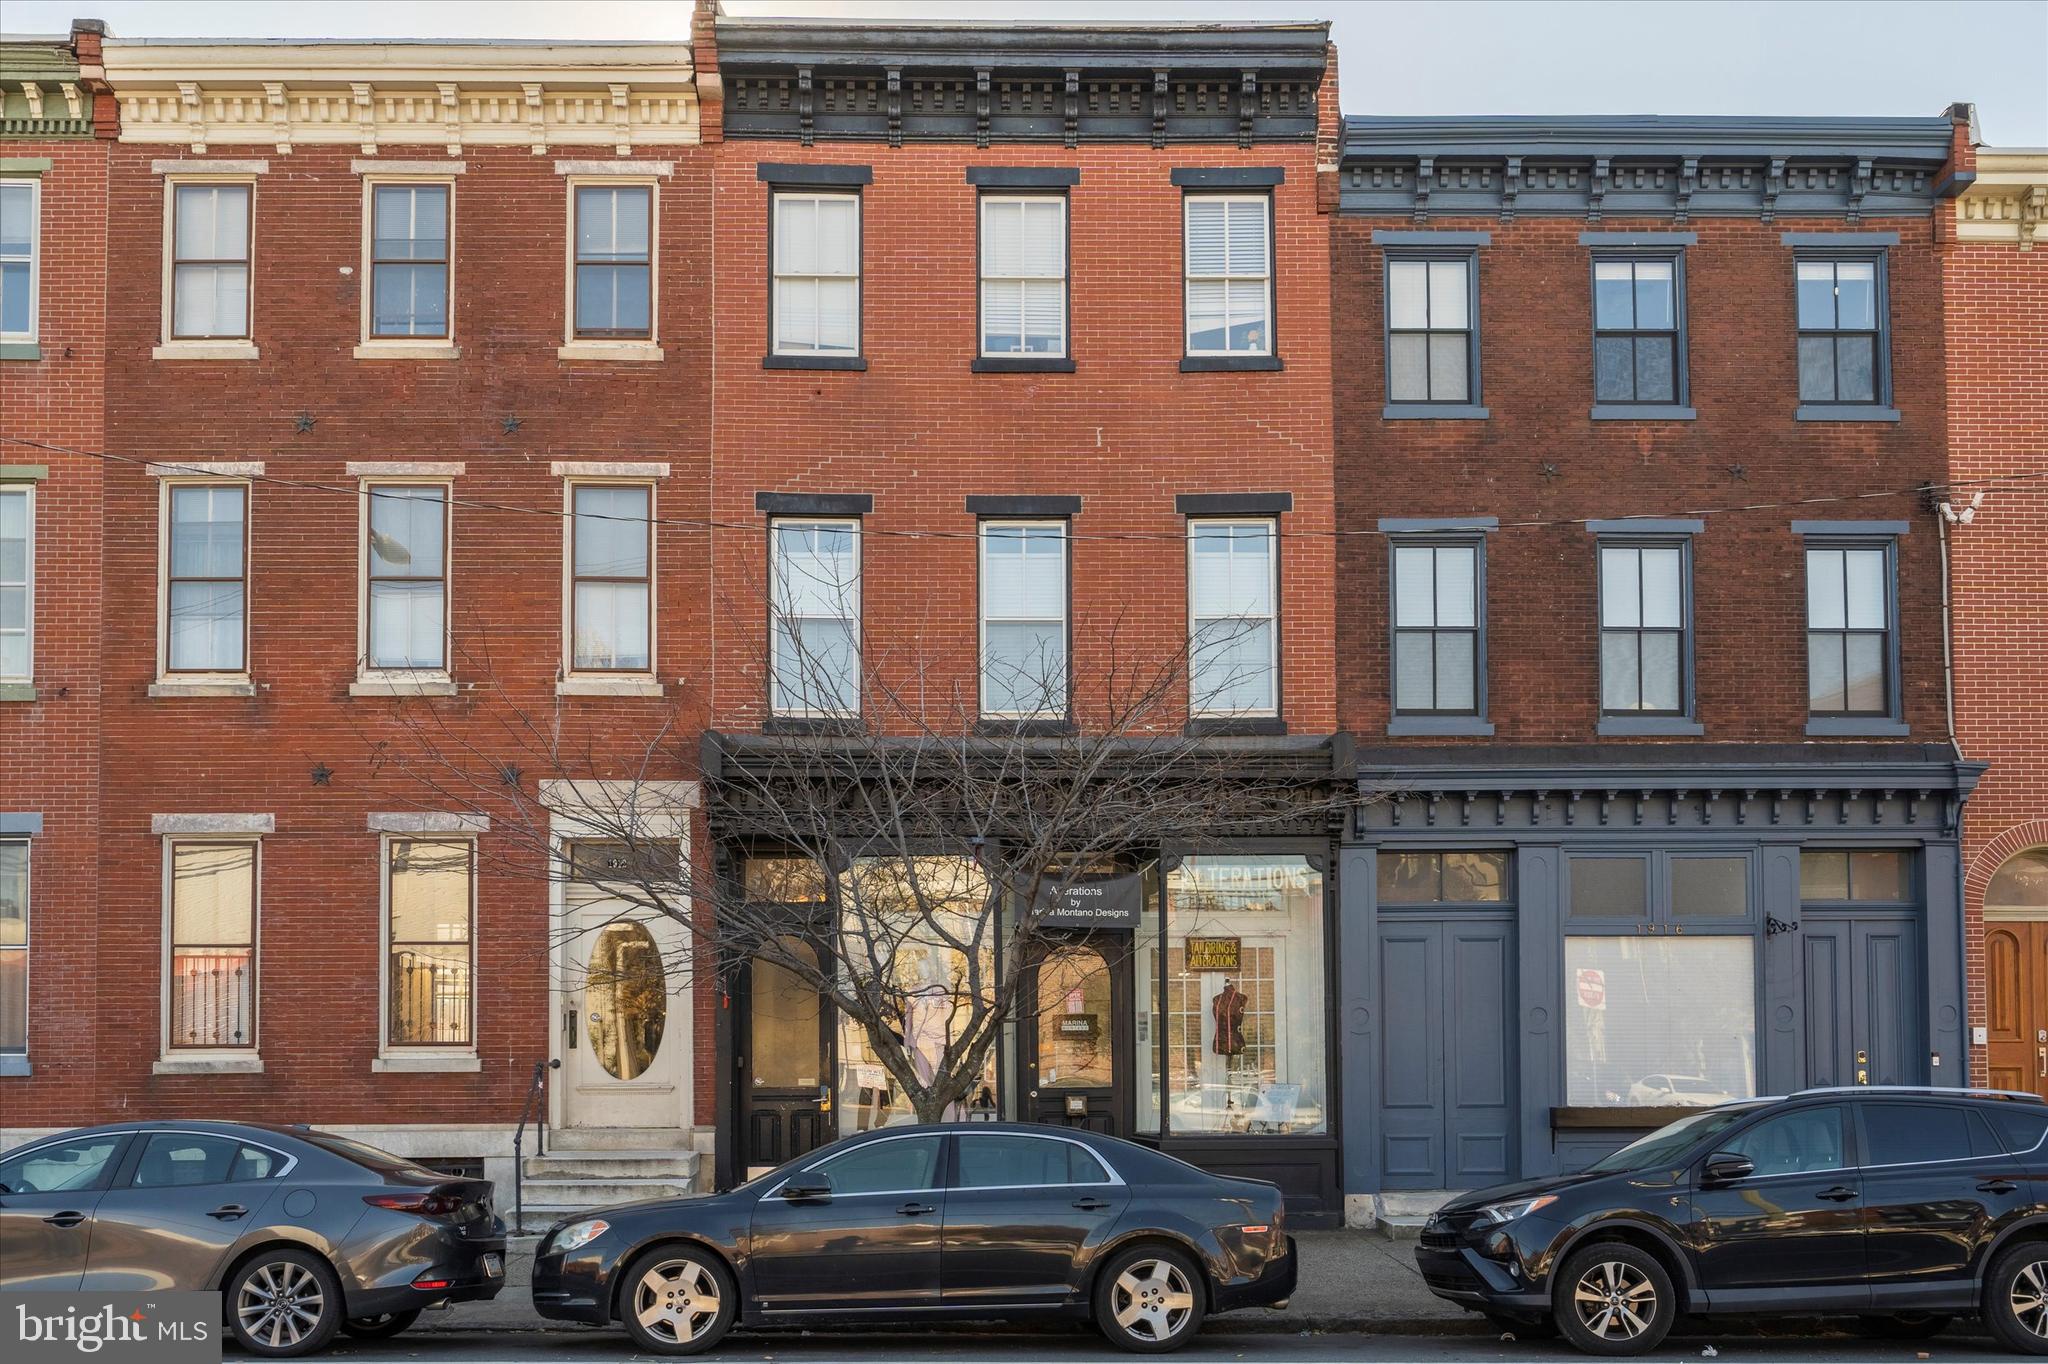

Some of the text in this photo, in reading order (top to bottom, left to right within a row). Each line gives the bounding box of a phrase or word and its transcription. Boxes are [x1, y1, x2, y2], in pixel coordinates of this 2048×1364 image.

[1070, 898, 1081, 907] by
[1057, 908, 1094, 916] Montano
[1095, 908, 1129, 918] Designs
[1637, 923, 1684, 935] 1916
[1191, 942, 1230, 954] TAILORING
[1190, 954, 1238, 967] ALTERATIONS
